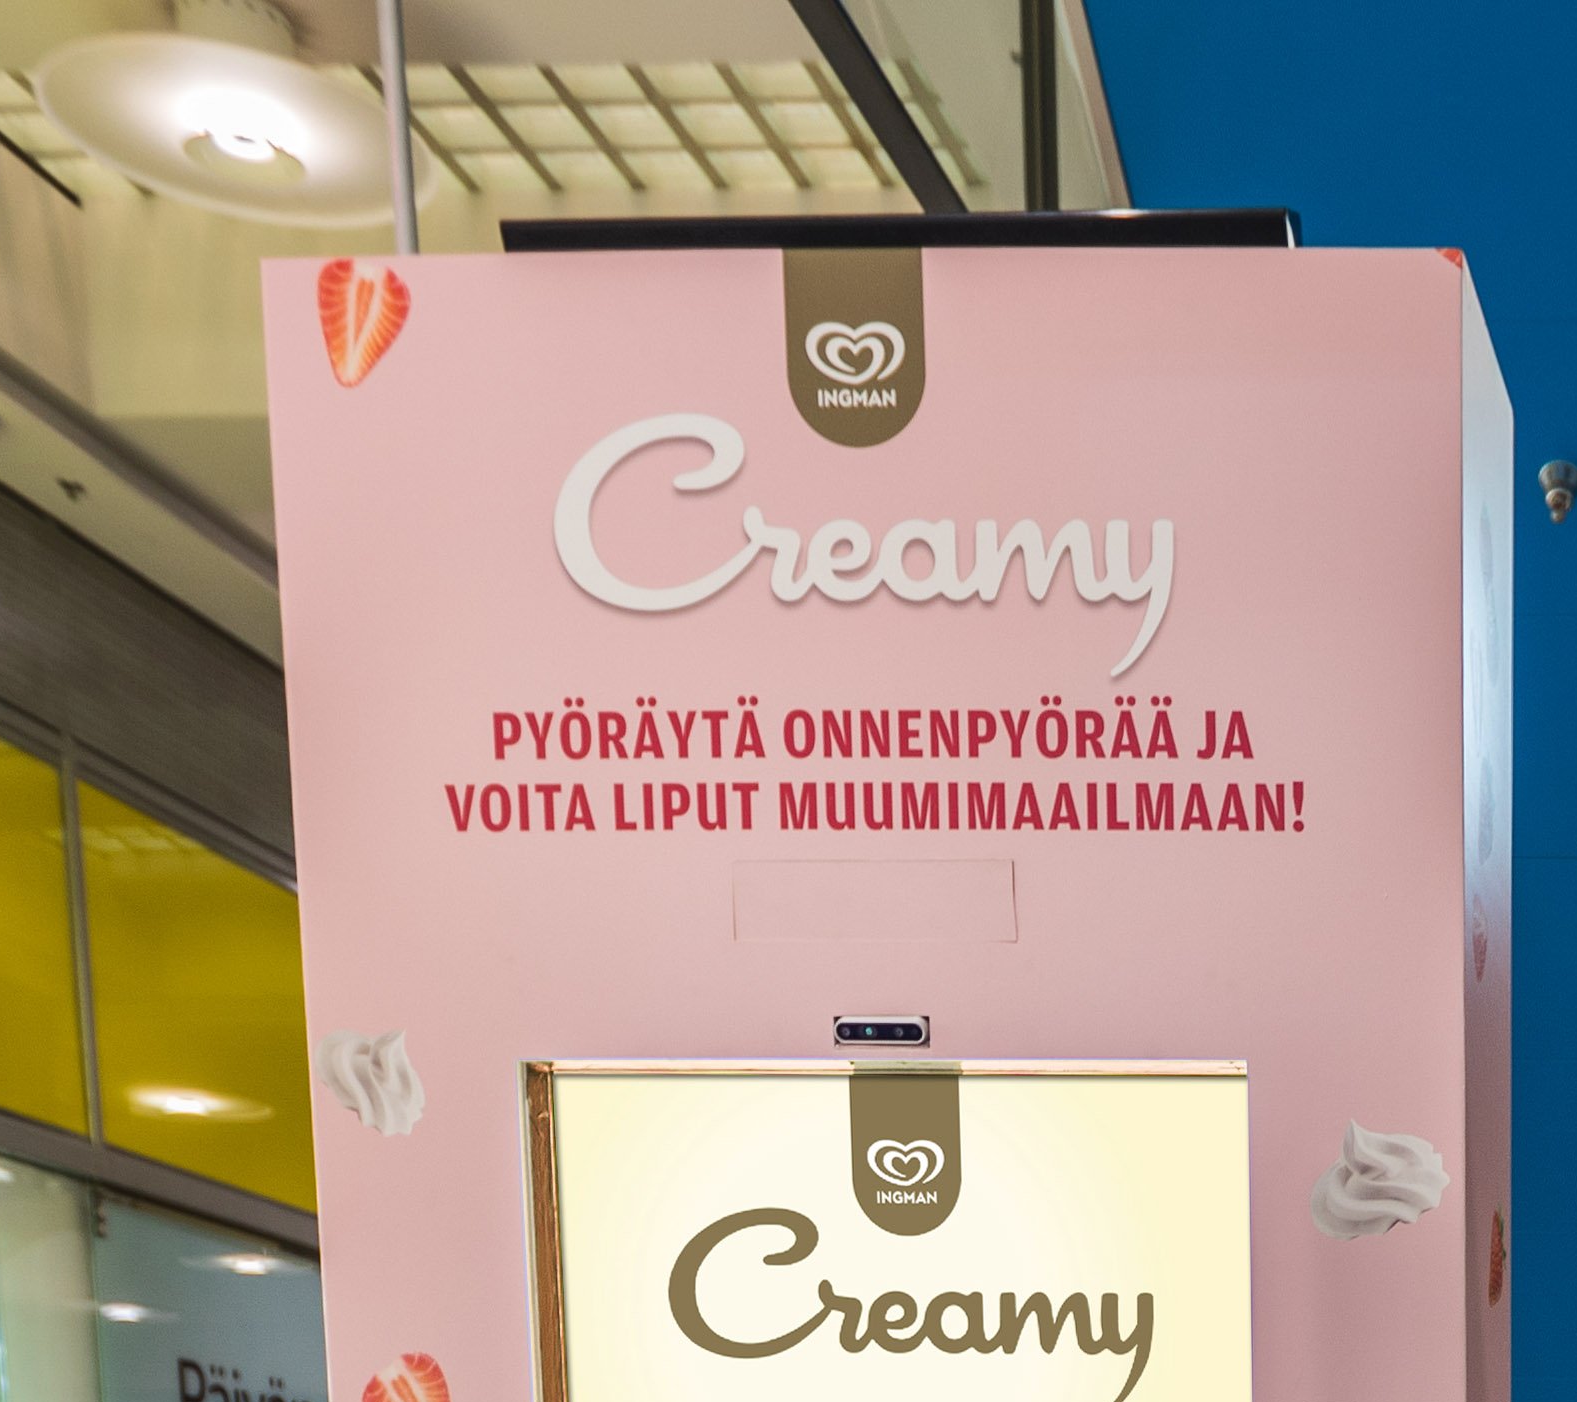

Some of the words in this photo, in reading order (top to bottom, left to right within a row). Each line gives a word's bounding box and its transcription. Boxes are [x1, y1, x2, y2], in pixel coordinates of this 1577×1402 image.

[817, 388, 898, 408] INGMAN
[553, 412, 1175, 678] Creamy
[492, 697, 767, 761] PYÖRÄYTÄ
[783, 695, 1179, 761] ONNENPYÖRÄÄ
[1195, 709, 1255, 761] JA
[445, 783, 596, 833] VOITA
[614, 782, 758, 832] LIPUT
[780, 780, 1307, 834] MUUMIMAAILMAAN!
[876, 1190, 938, 1205] INGMAN
